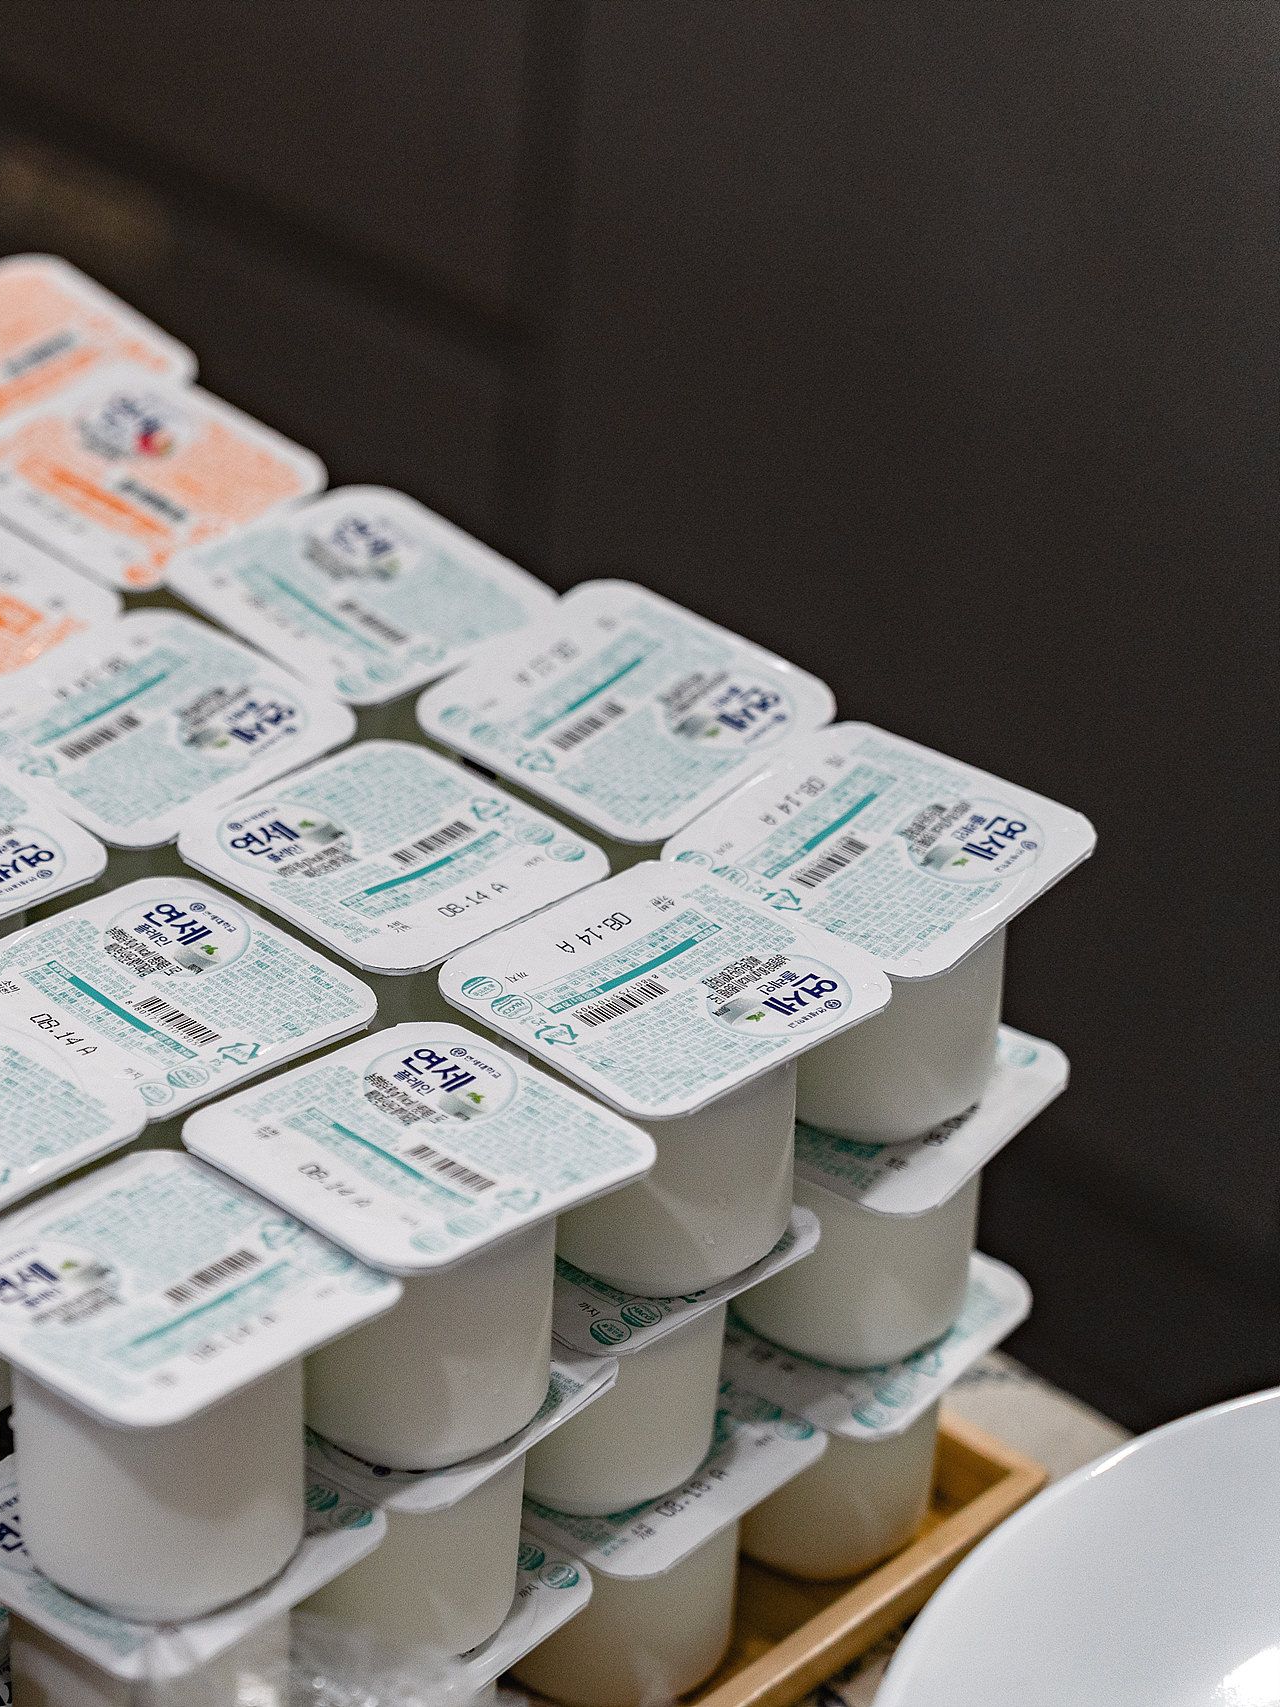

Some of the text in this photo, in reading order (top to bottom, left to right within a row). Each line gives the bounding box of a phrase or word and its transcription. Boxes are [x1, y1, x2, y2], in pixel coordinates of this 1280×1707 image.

[231, 821, 299, 856] 연세
[962, 817, 1027, 861] 연세
[438, 884, 509, 918] 08.14 A
[134, 923, 173, 947] 플레인
[144, 904, 212, 946] 연세
[556, 912, 632, 954] 08.14 A
[505, 972, 529, 984] 까지
[757, 971, 800, 995] 플레인
[763, 974, 838, 1016] 연세
[30, 1014, 98, 1056] 08.14 A
[788, 1007, 827, 1029] 연세대학교
[394, 1070, 435, 1096] 플레인
[403, 1049, 476, 1092] 연세
[578, 1302, 600, 1318] 까지
